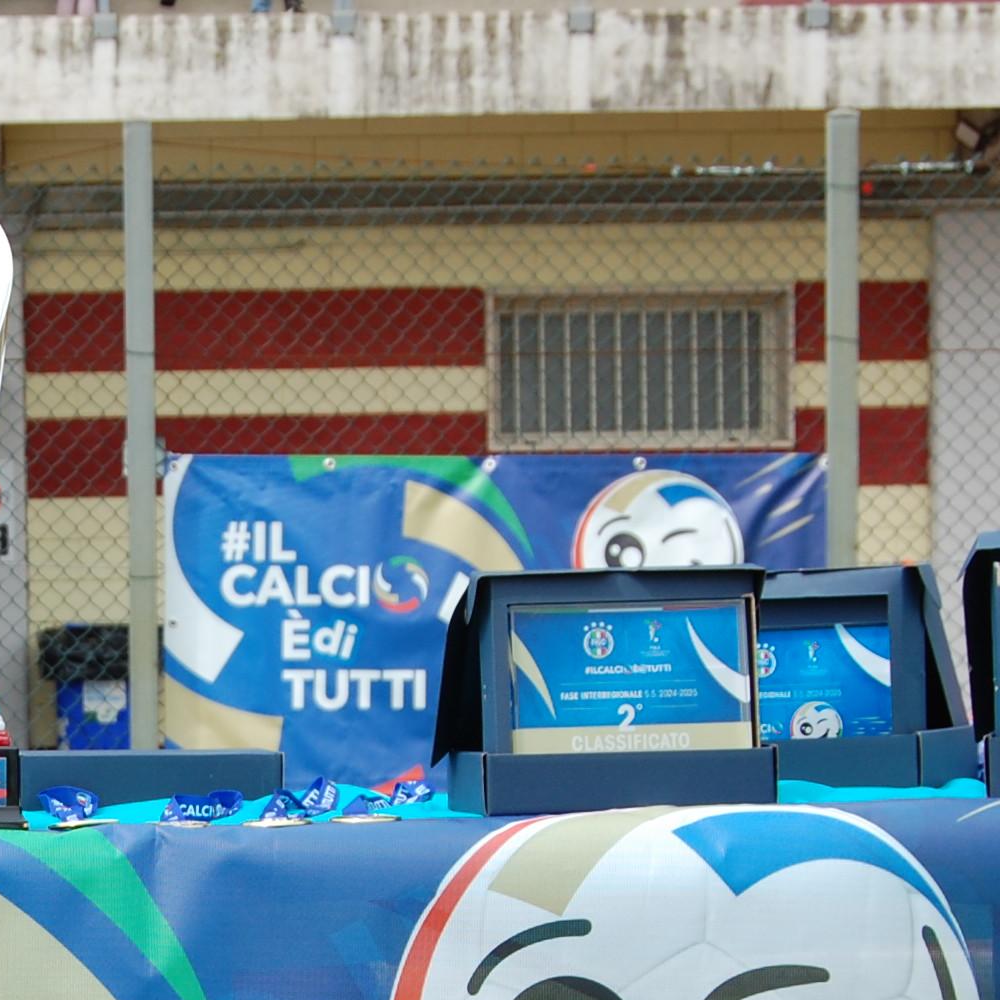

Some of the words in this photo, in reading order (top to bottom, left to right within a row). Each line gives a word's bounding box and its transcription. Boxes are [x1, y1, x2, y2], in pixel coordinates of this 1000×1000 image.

[221, 520, 297, 562] #IL
[280, 668, 427, 711] TUTTI
[571, 732, 691, 751] CLASSIFICATO
